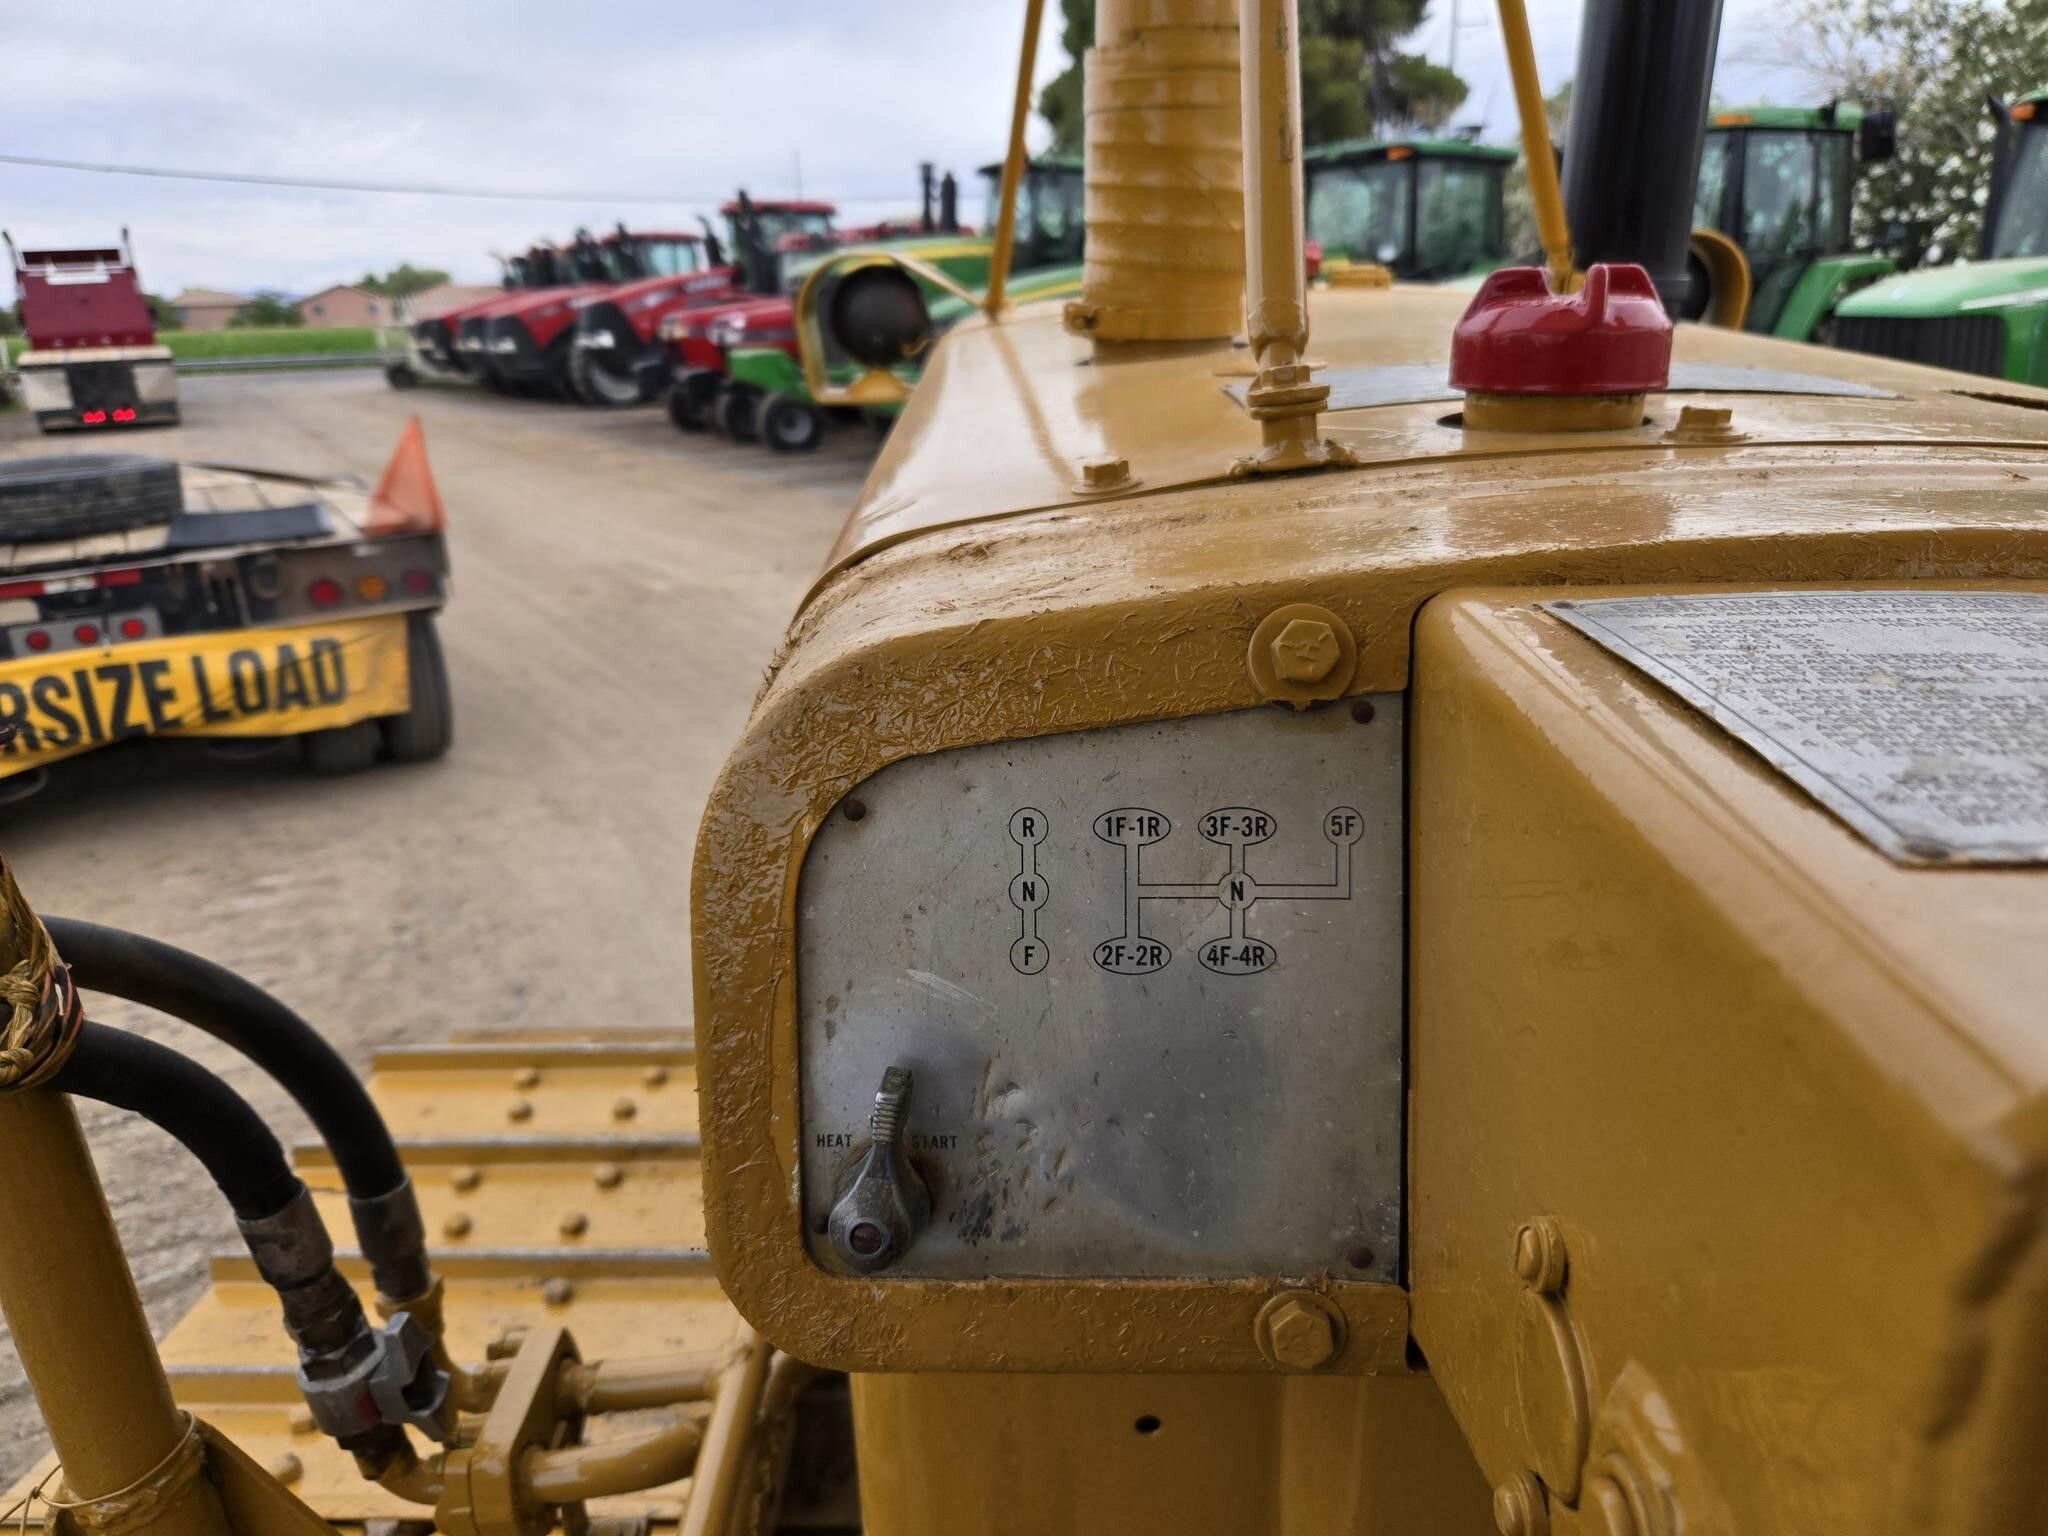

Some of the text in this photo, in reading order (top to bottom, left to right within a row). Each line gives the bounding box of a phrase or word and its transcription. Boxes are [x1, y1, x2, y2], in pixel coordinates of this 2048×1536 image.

[190, 638, 348, 725] LOAD
[1022, 816, 1035, 838] R
[1104, 816, 1160, 838] 1F-1R
[1206, 816, 1268, 838] 3F-3R
[1331, 815, 1356, 837] 5F
[1022, 880, 1036, 902] N
[1230, 880, 1244, 902] N
[1023, 945, 1035, 966] F
[1101, 944, 1163, 966] 2F-2R
[1206, 944, 1266, 966] 4F-4R
[816, 1133, 853, 1148] HEAT
[911, 1134, 958, 1150] START
